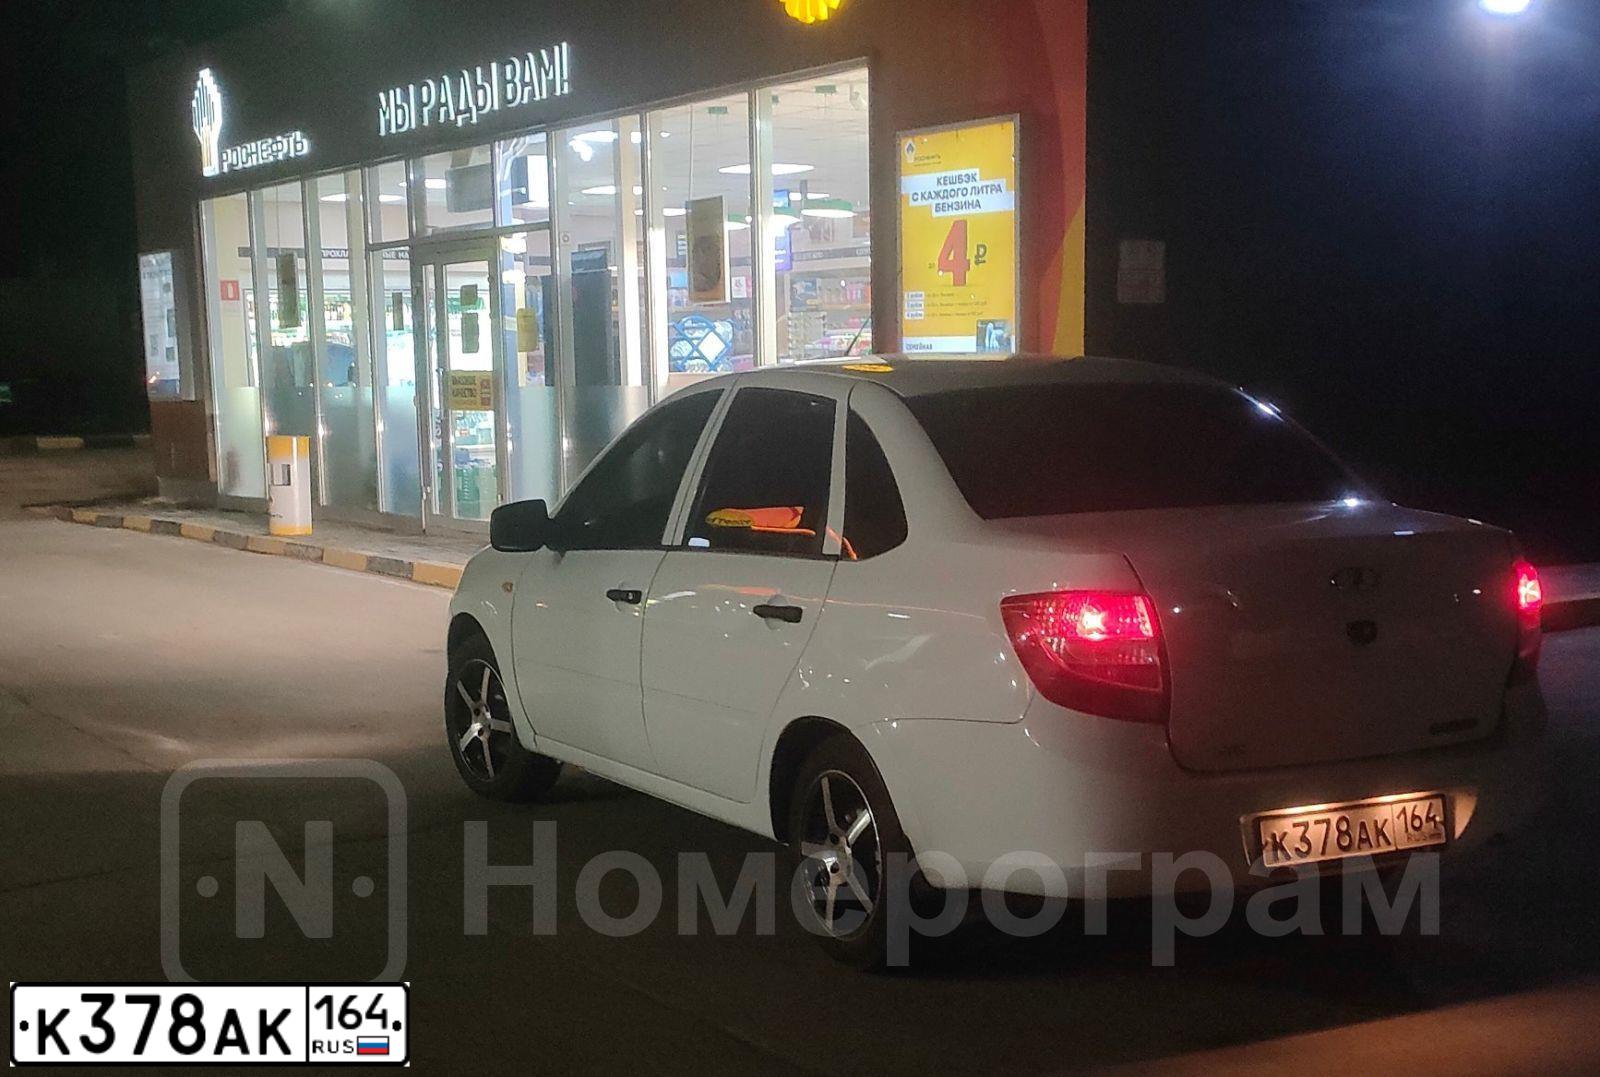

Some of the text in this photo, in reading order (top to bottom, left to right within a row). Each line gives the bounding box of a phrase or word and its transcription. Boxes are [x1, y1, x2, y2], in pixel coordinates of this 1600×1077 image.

[378, 41, 570, 136] МЫ РАДЫ ВАМ!
[221, 131, 311, 174] РОСНЕФТЬ
[911, 183, 1003, 202] С КАЖДОГО ЛИТРА
[936, 172, 978, 187] КЕШБЭК
[934, 198, 982, 213] БЕНЗИНА
[937, 219, 971, 287] 4
[1270, 801, 1438, 863] К378АК 164
